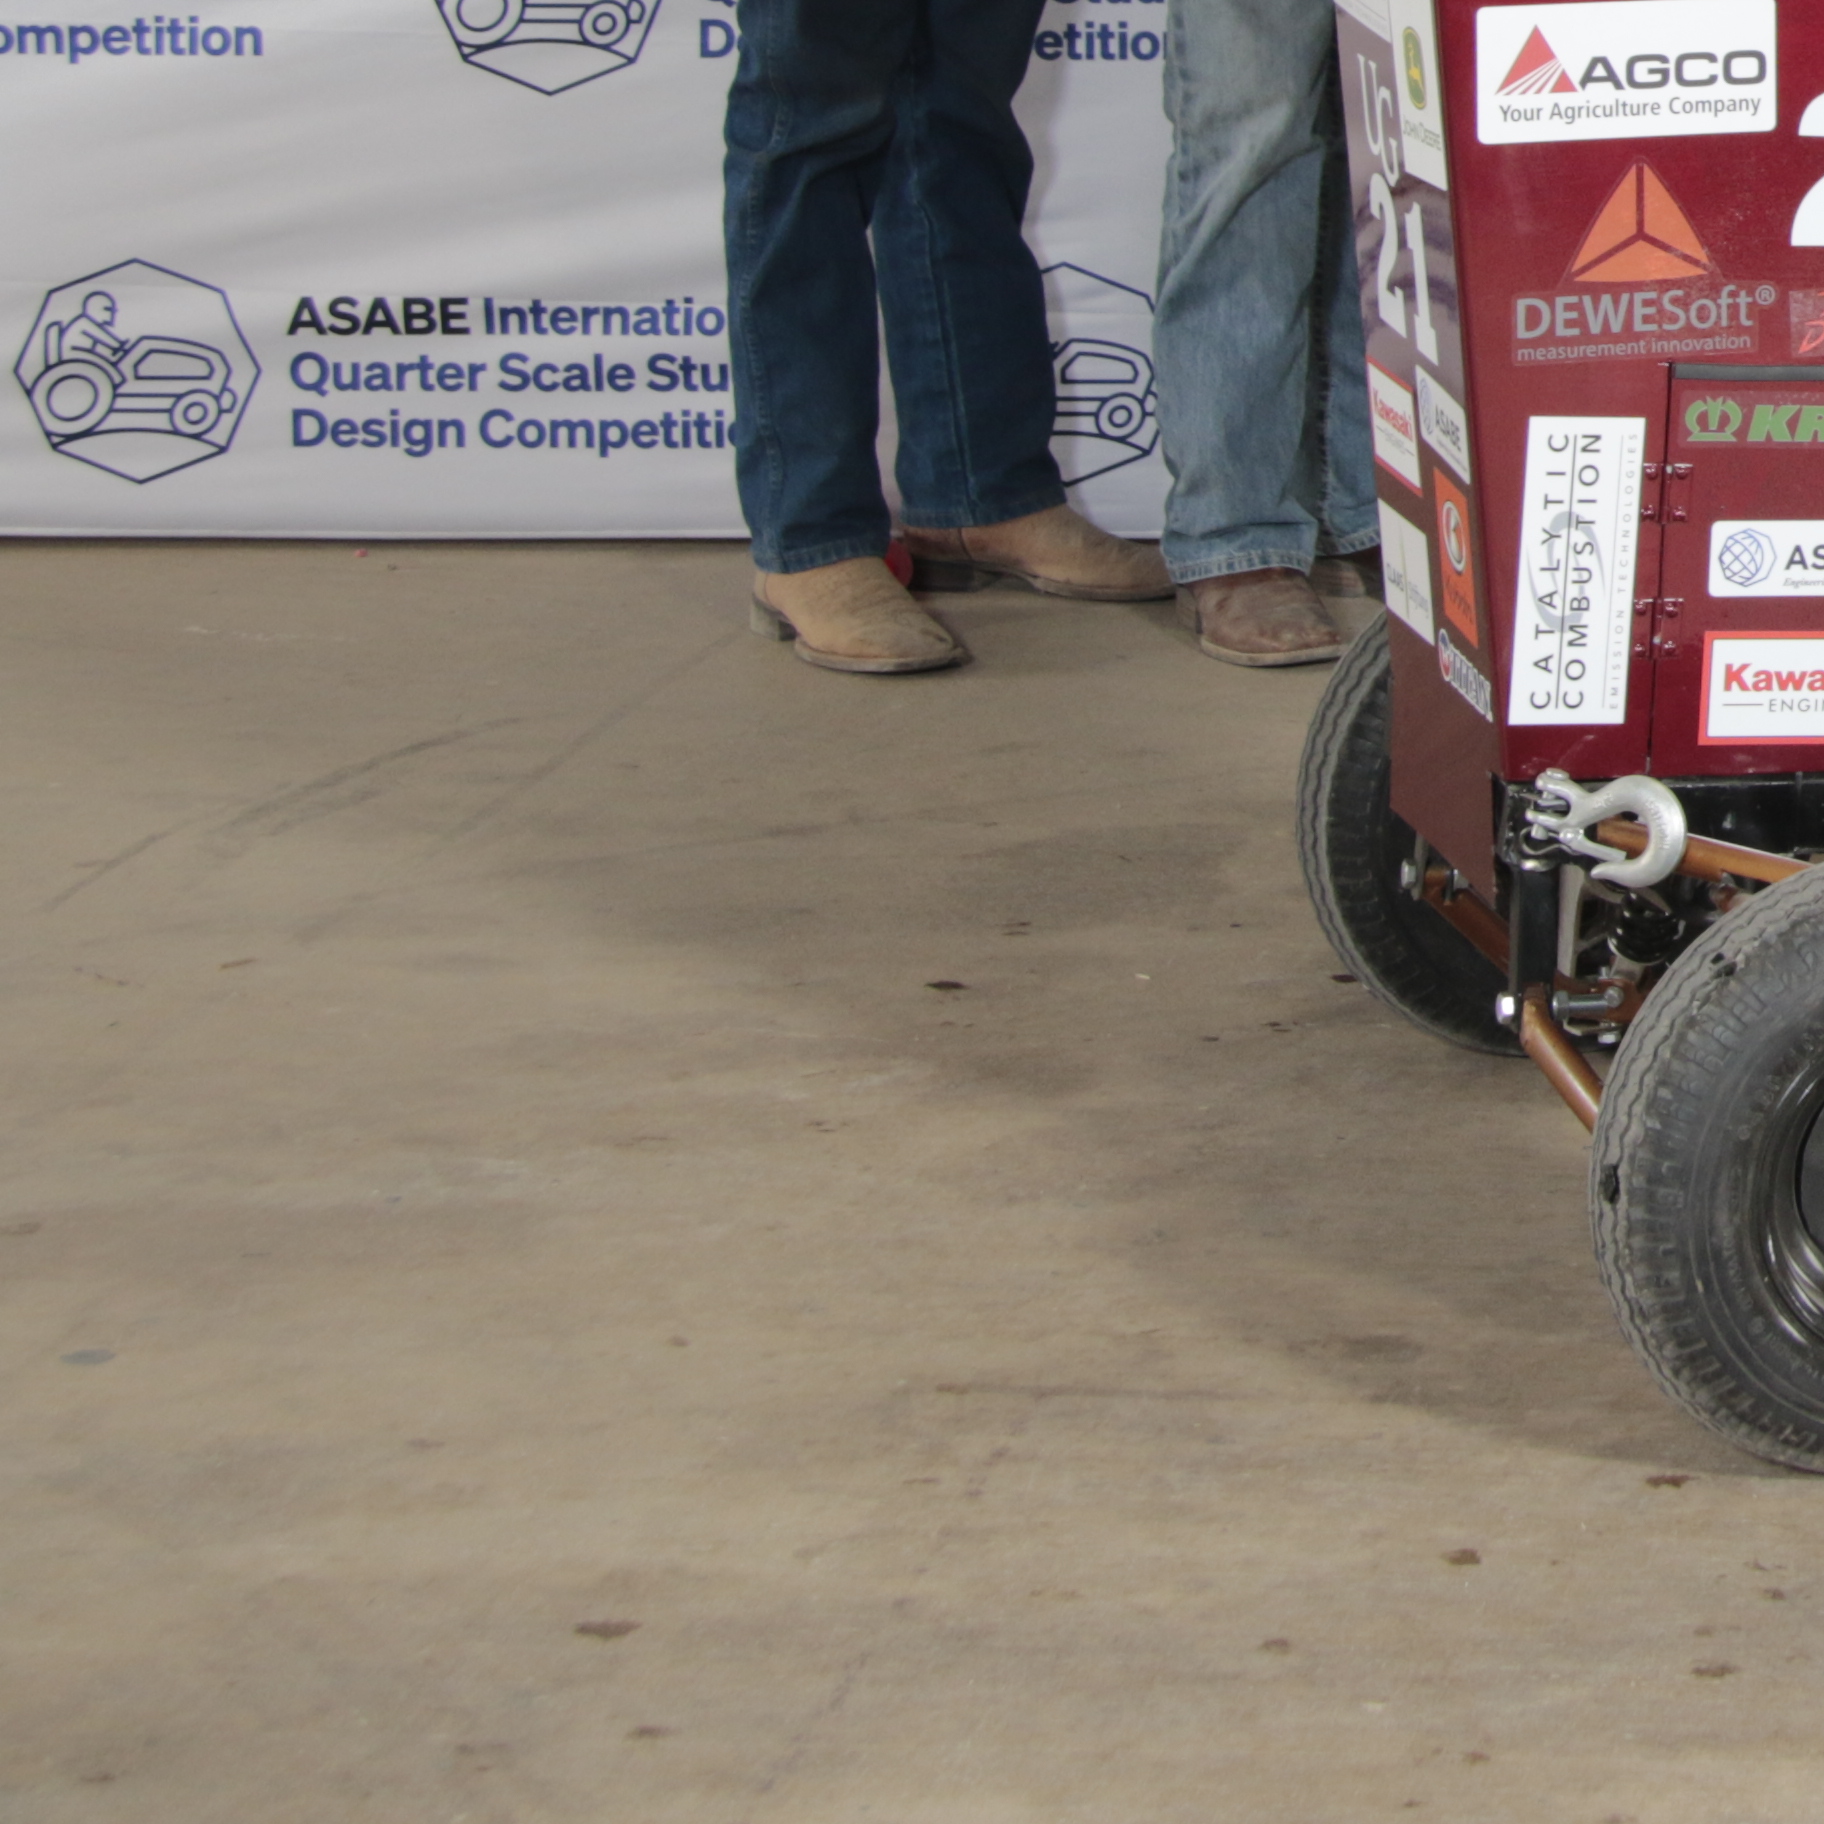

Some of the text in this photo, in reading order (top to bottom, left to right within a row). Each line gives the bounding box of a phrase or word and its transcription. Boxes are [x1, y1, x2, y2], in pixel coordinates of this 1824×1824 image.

[1579, 50, 1767, 91] AGCO
[1357, 52, 1399, 188] UG
[1499, 95, 1762, 125] Your Agriculture Company
[1369, 172, 1440, 367] 21
[286, 296, 725, 336] ASABE Internatio
[1517, 334, 1751, 361] measurement innovation
[290, 351, 487, 397] Quarter
[498, 352, 636, 392] Scale
[292, 408, 737, 458] Design Competiti
[1372, 387, 1414, 443] Kawasaki
[1434, 405, 1461, 453] ASABE
[1530, 433, 1569, 710] CATALYTIC
[1562, 434, 1602, 710] COMBUSTION
[1609, 432, 1638, 710] EMISSION TECHNOLOGIES
